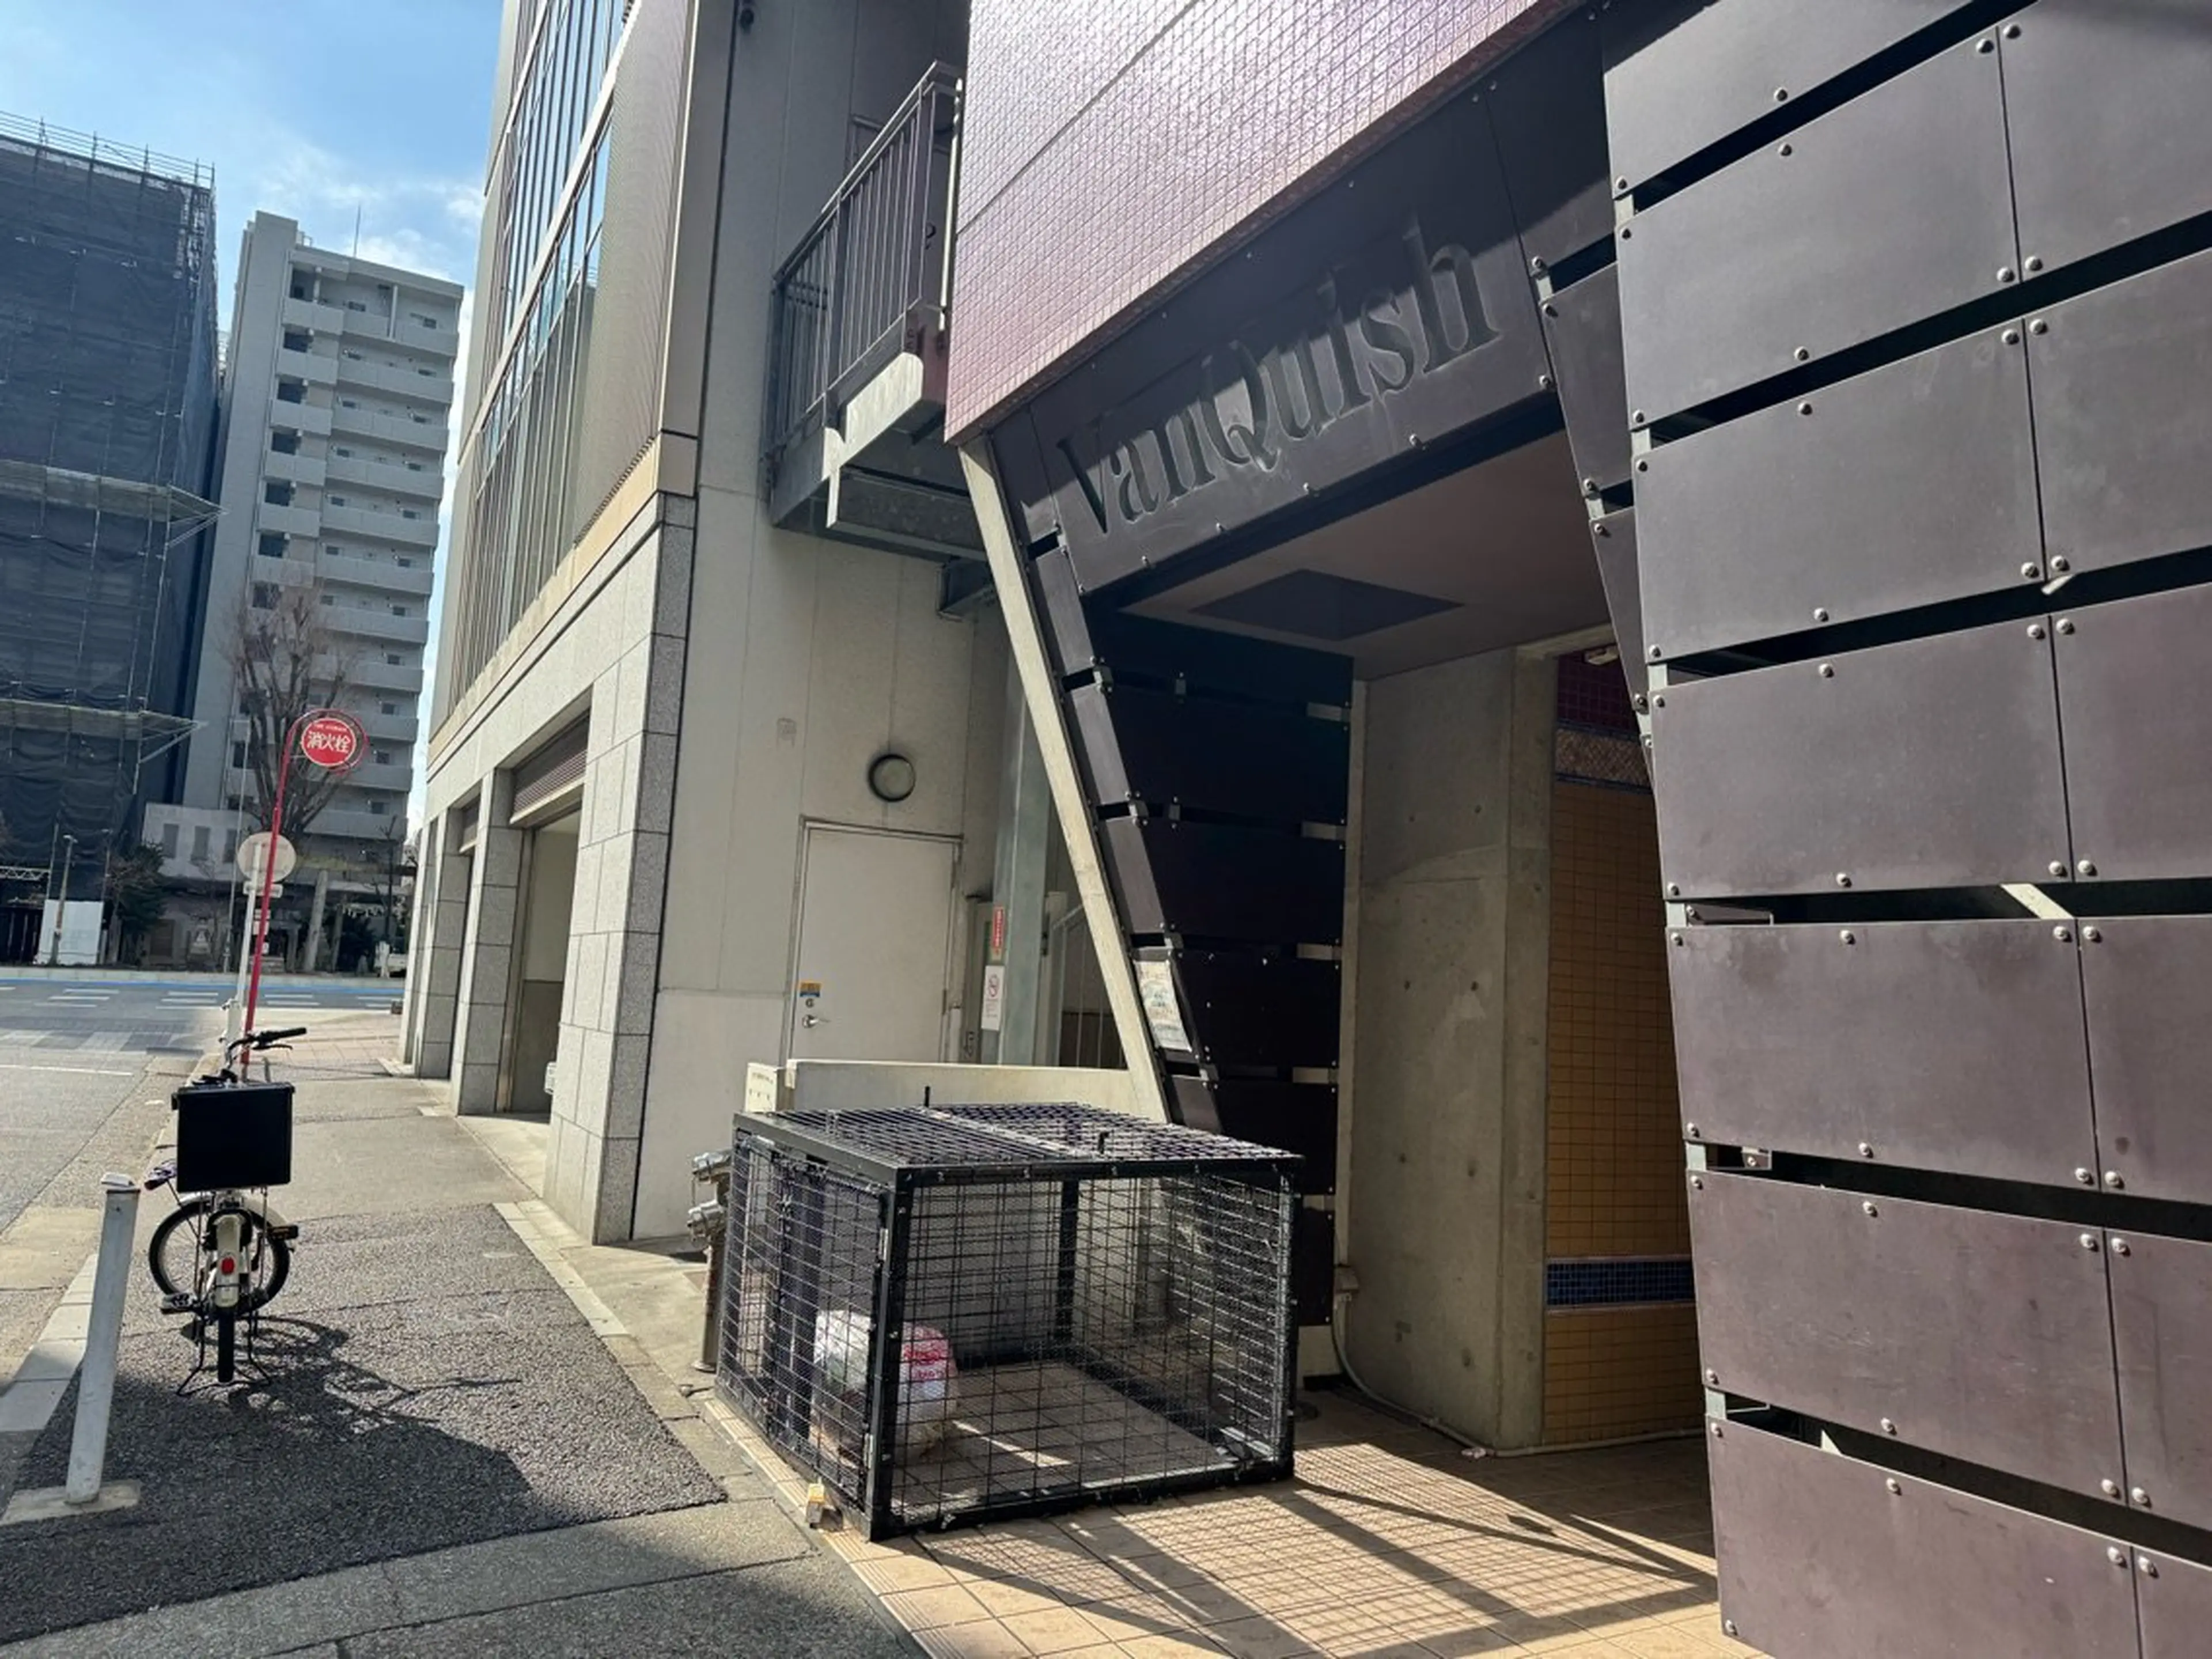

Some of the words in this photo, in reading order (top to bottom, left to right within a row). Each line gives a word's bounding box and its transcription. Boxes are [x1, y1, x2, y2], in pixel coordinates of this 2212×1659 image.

[1056, 214, 1501, 535] VanQuish
[307, 730, 351, 753] 消火栓
